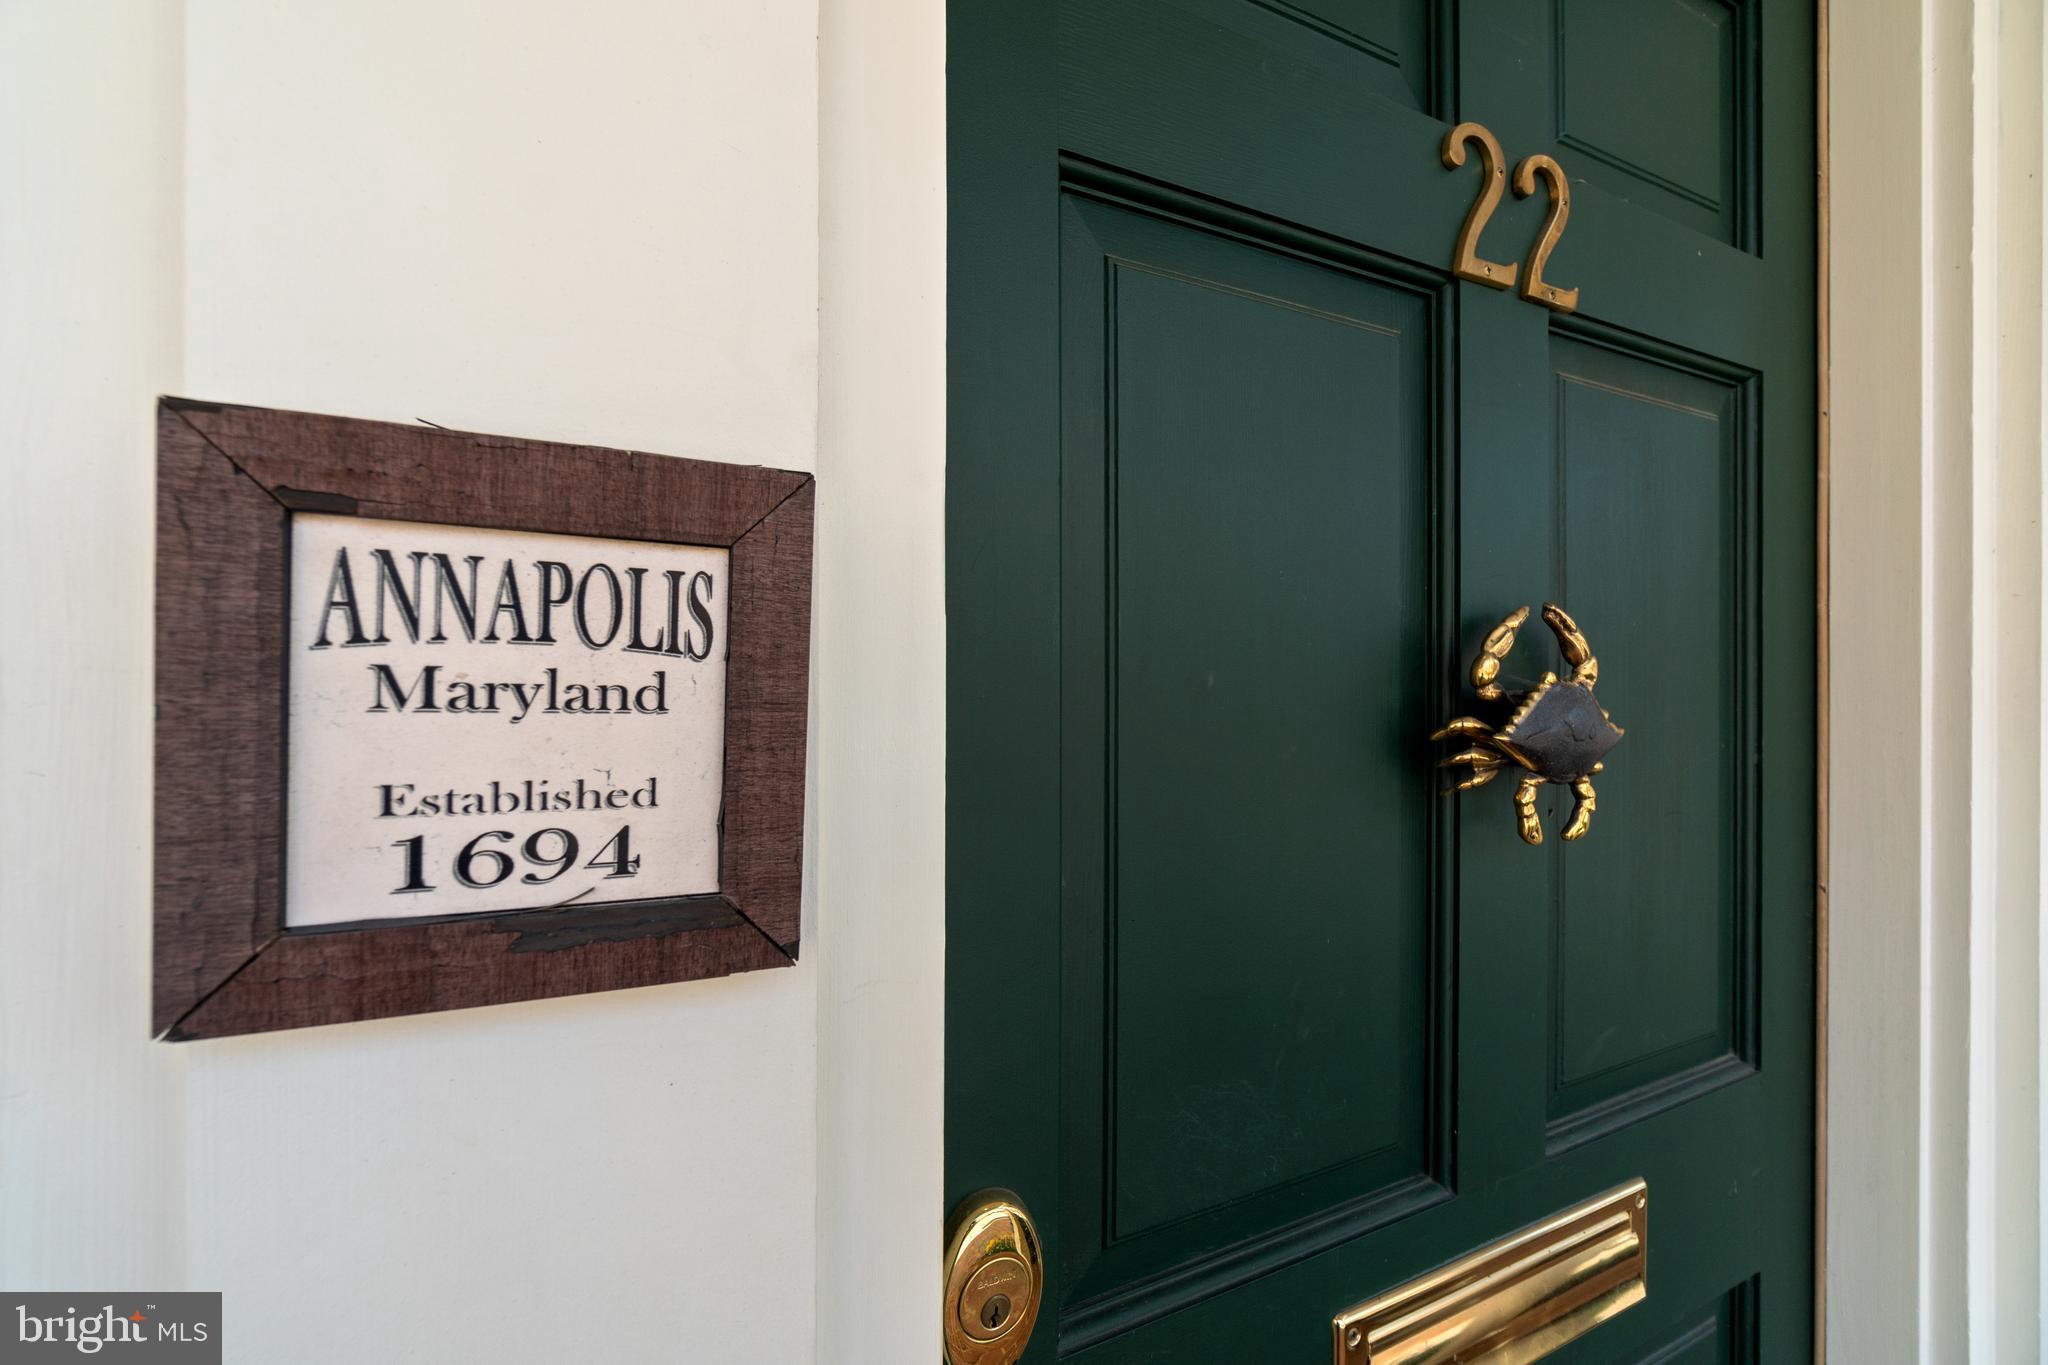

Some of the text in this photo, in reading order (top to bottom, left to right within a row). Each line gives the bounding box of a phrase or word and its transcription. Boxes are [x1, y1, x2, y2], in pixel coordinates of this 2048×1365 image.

[1441, 121, 1579, 314] 22
[309, 546, 714, 662] ANNAPOLIS
[367, 664, 669, 724] Maryland
[374, 777, 659, 819] Established
[390, 825, 641, 894] 1694
